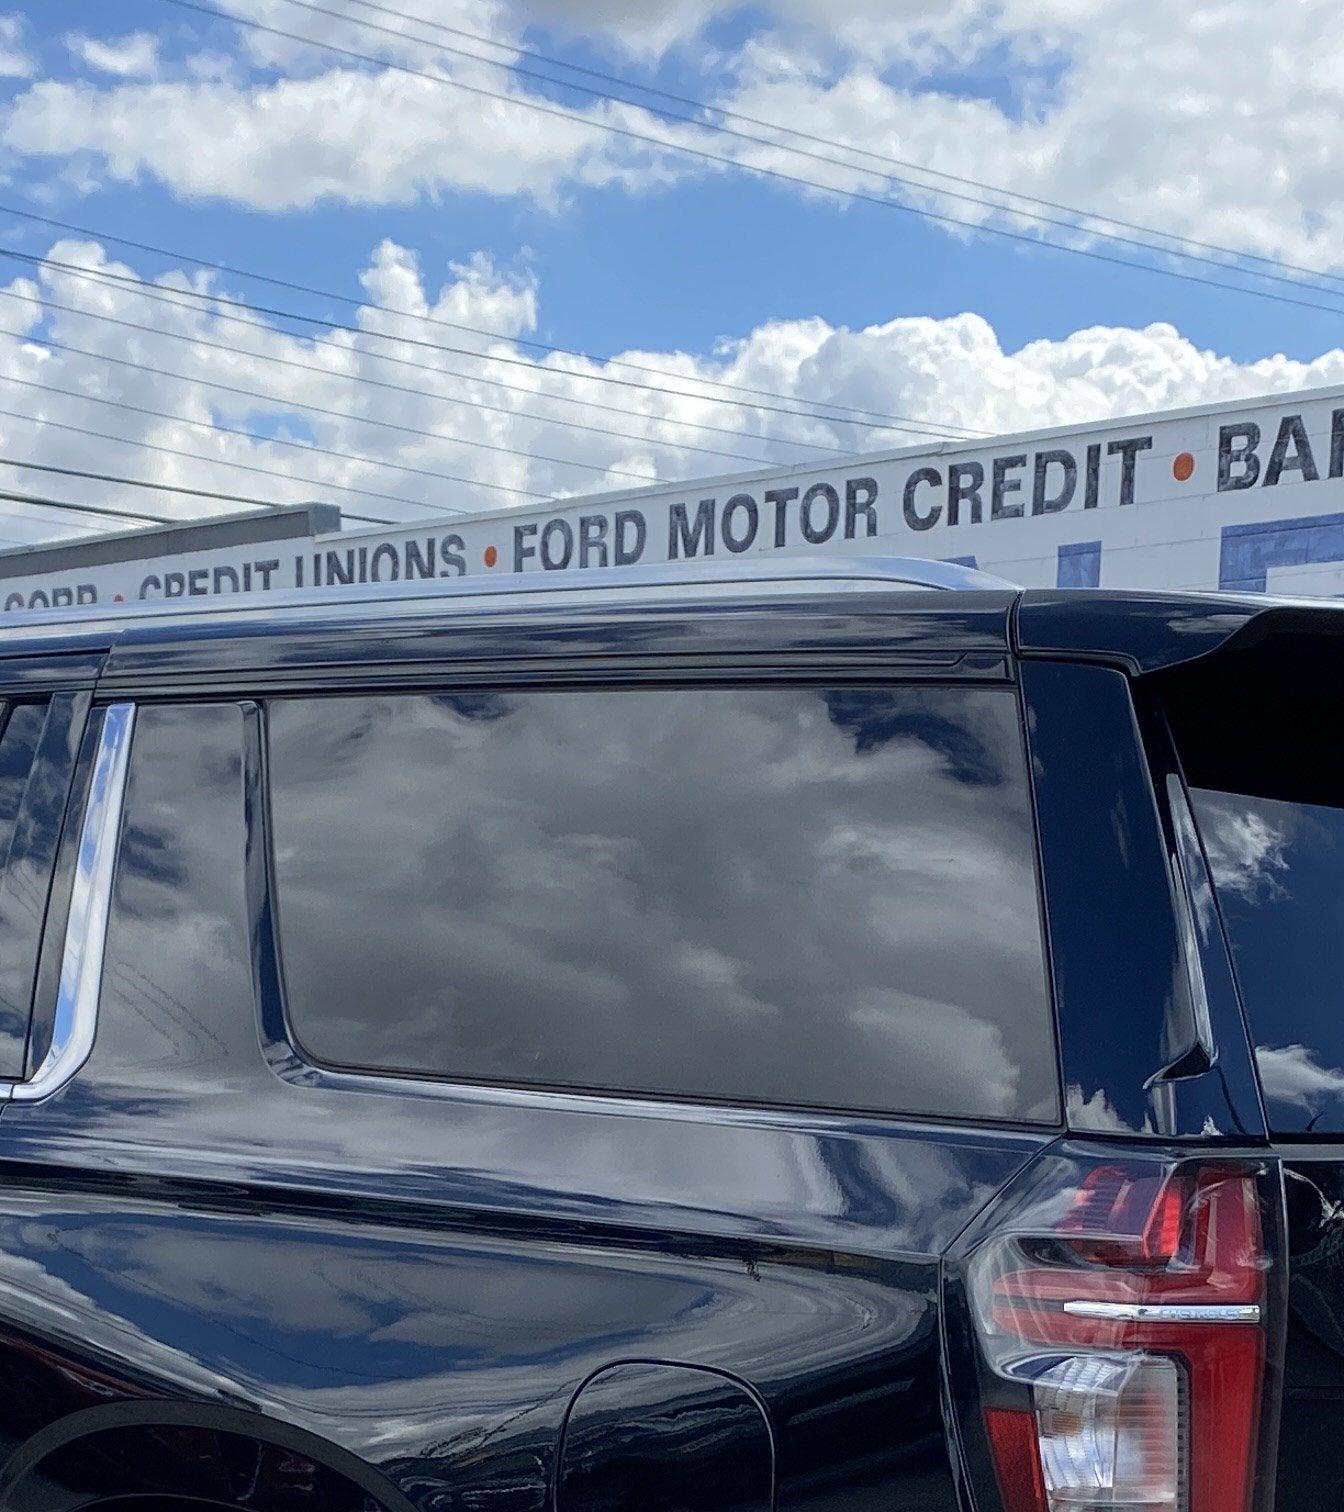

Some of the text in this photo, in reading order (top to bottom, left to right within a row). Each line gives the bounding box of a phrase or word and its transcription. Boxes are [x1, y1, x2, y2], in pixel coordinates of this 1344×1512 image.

[295, 533, 467, 588] UNIONS
[512, 510, 647, 573] FORD
[668, 478, 878, 561] MOTOR
[904, 436, 1153, 532] CREDIT
